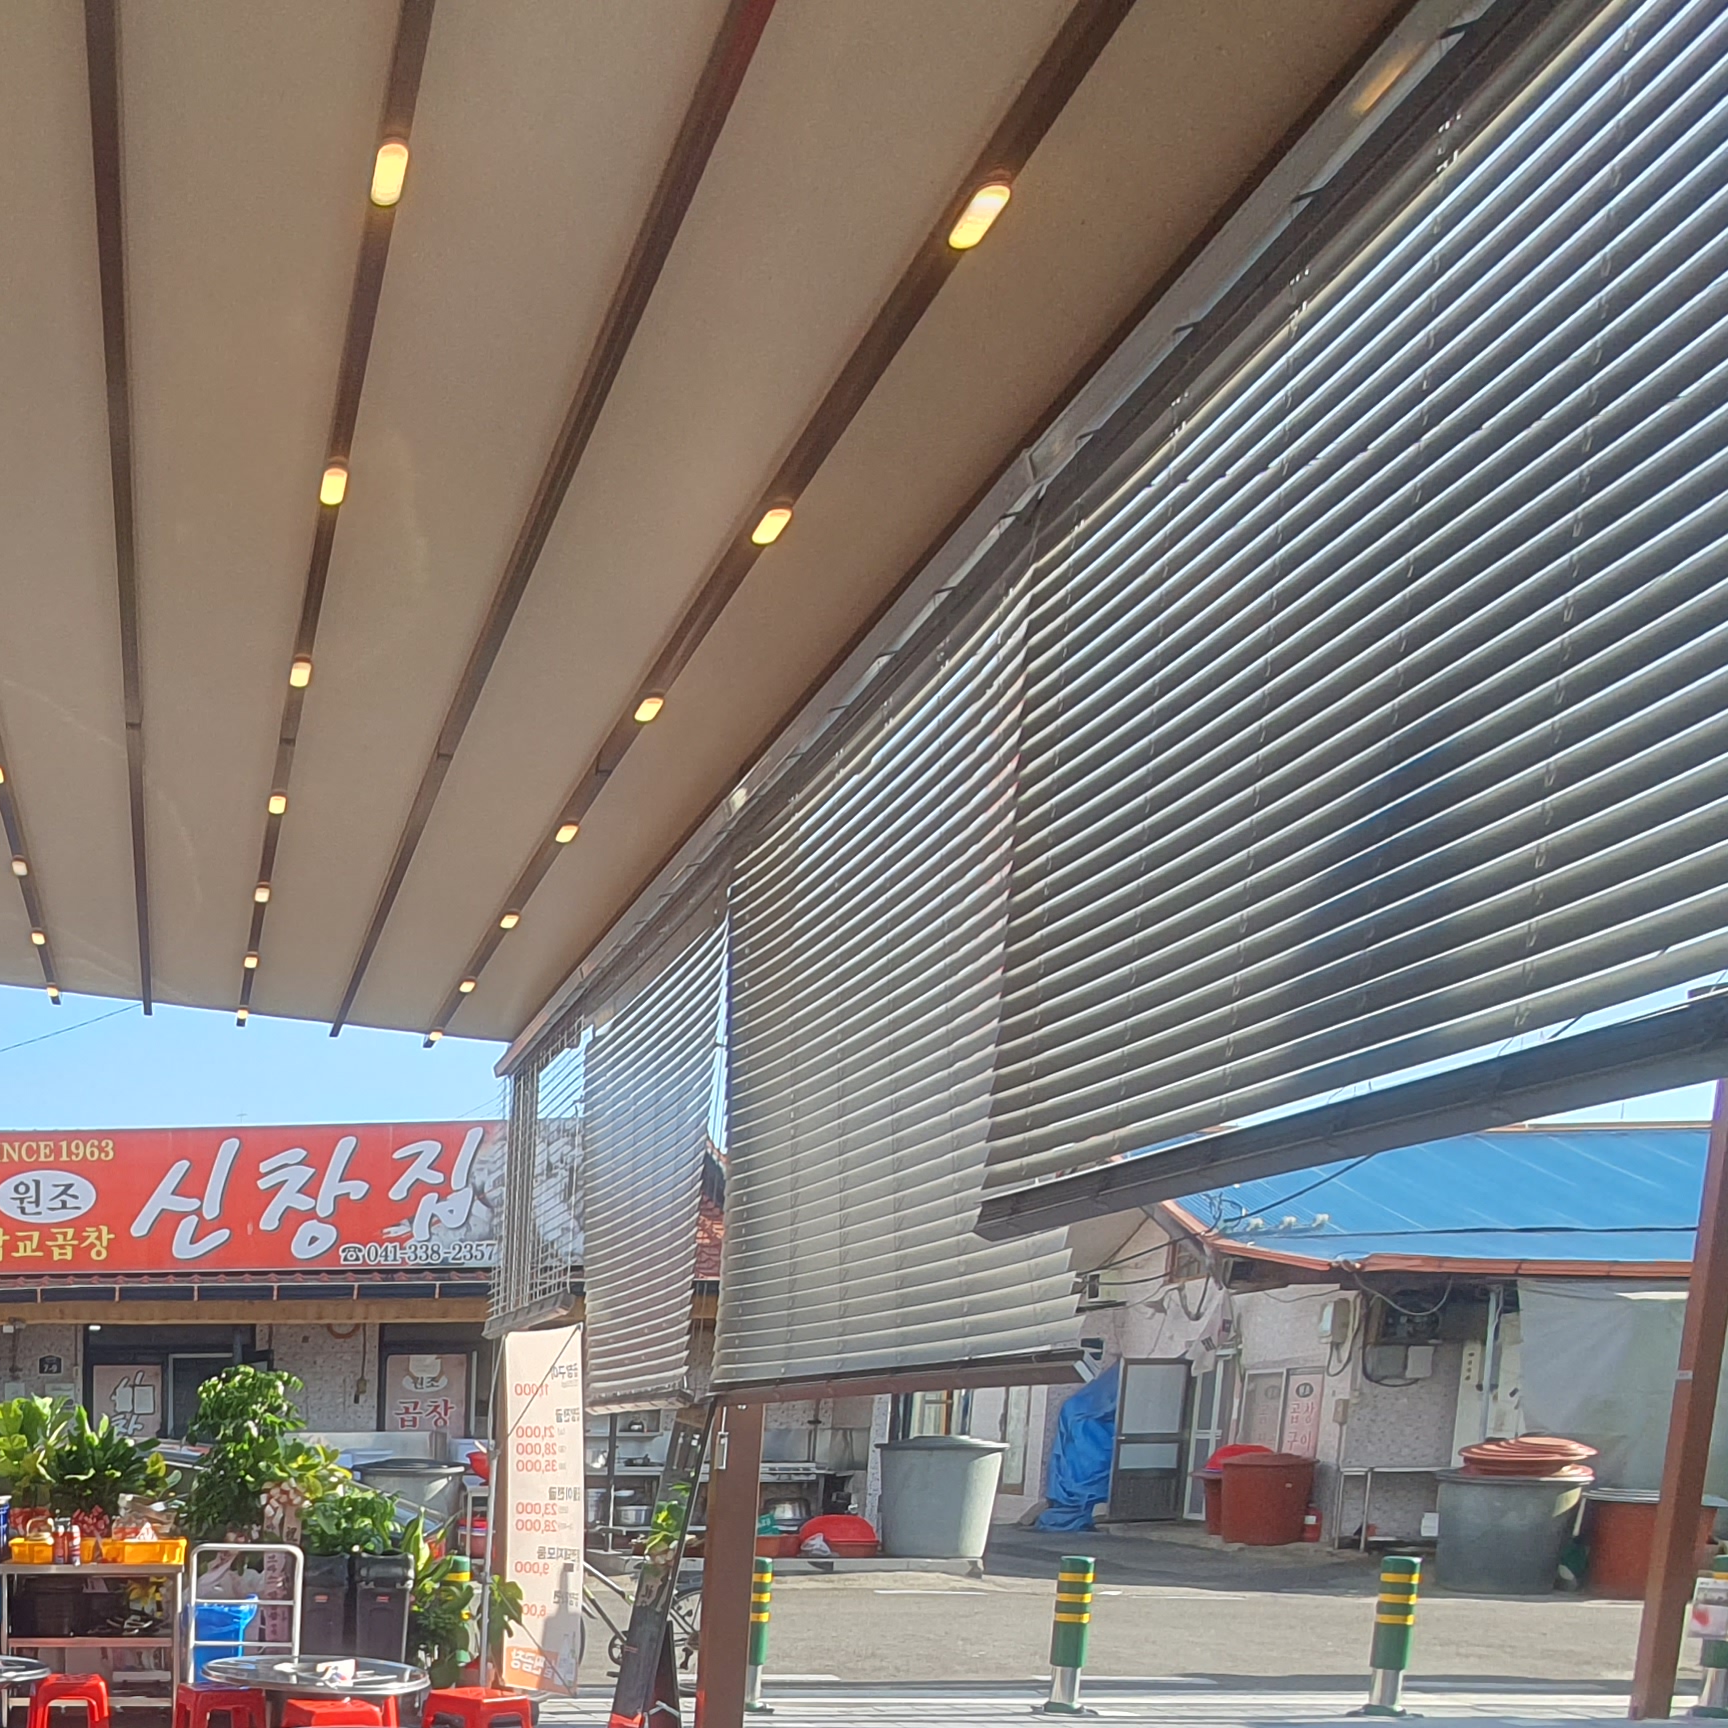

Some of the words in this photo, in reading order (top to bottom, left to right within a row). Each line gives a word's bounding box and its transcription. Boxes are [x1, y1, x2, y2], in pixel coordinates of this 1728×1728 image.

[58, 1139, 114, 1162] 1963
[9, 1178, 82, 1218] 원조
[365, 1242, 497, 1267] 041-338-2357
[394, 1399, 455, 1429] 곱창
[1287, 1430, 1313, 1451] 구이
